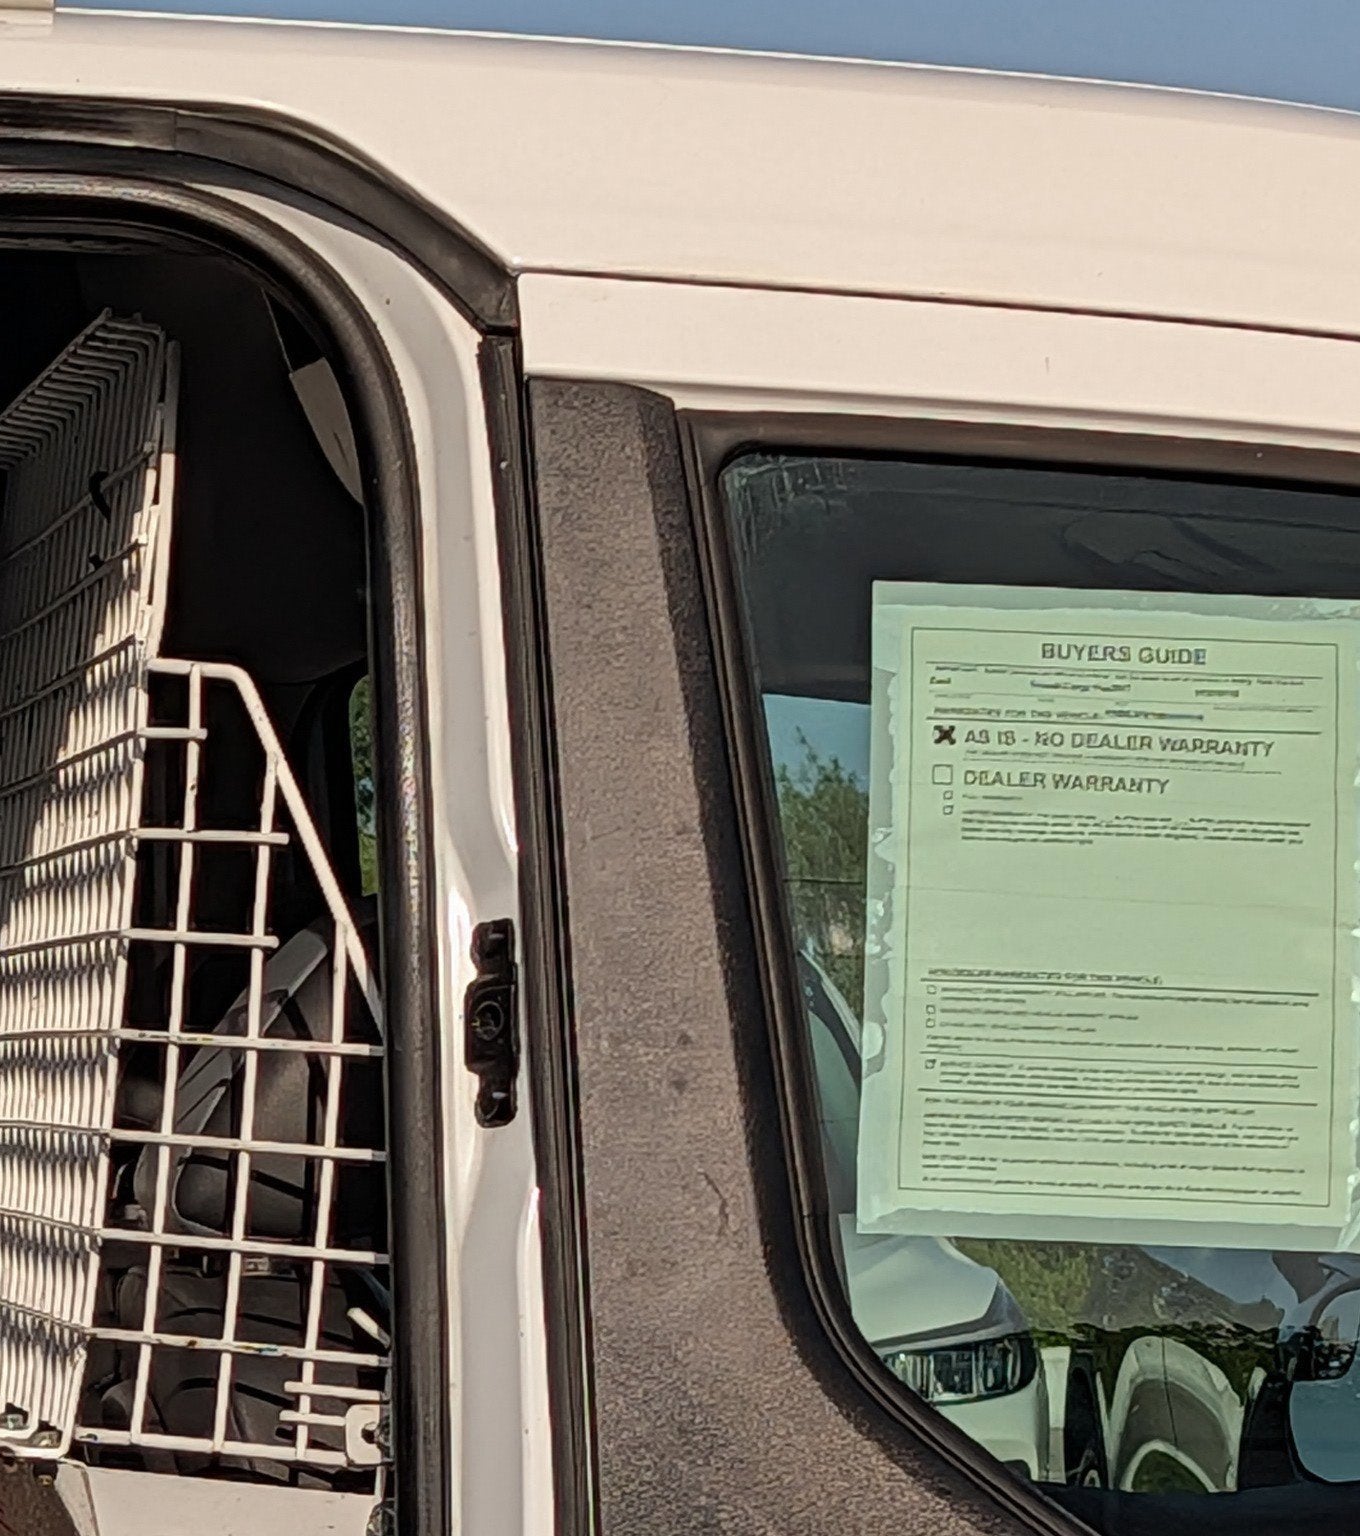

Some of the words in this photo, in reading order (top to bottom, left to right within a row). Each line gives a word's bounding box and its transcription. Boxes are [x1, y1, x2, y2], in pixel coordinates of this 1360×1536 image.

[1041, 642, 1131, 662] BUYERS
[1137, 646, 1207, 666] GUIDE
[964, 730, 990, 744] AS
[997, 731, 1016, 745] IS
[1035, 731, 1064, 748] NO
[1071, 733, 1152, 751] DEALER
[1159, 737, 1275, 757] WARRANTY
[963, 769, 1046, 789] DEALER
[1052, 774, 1170, 795] WARRANTY
